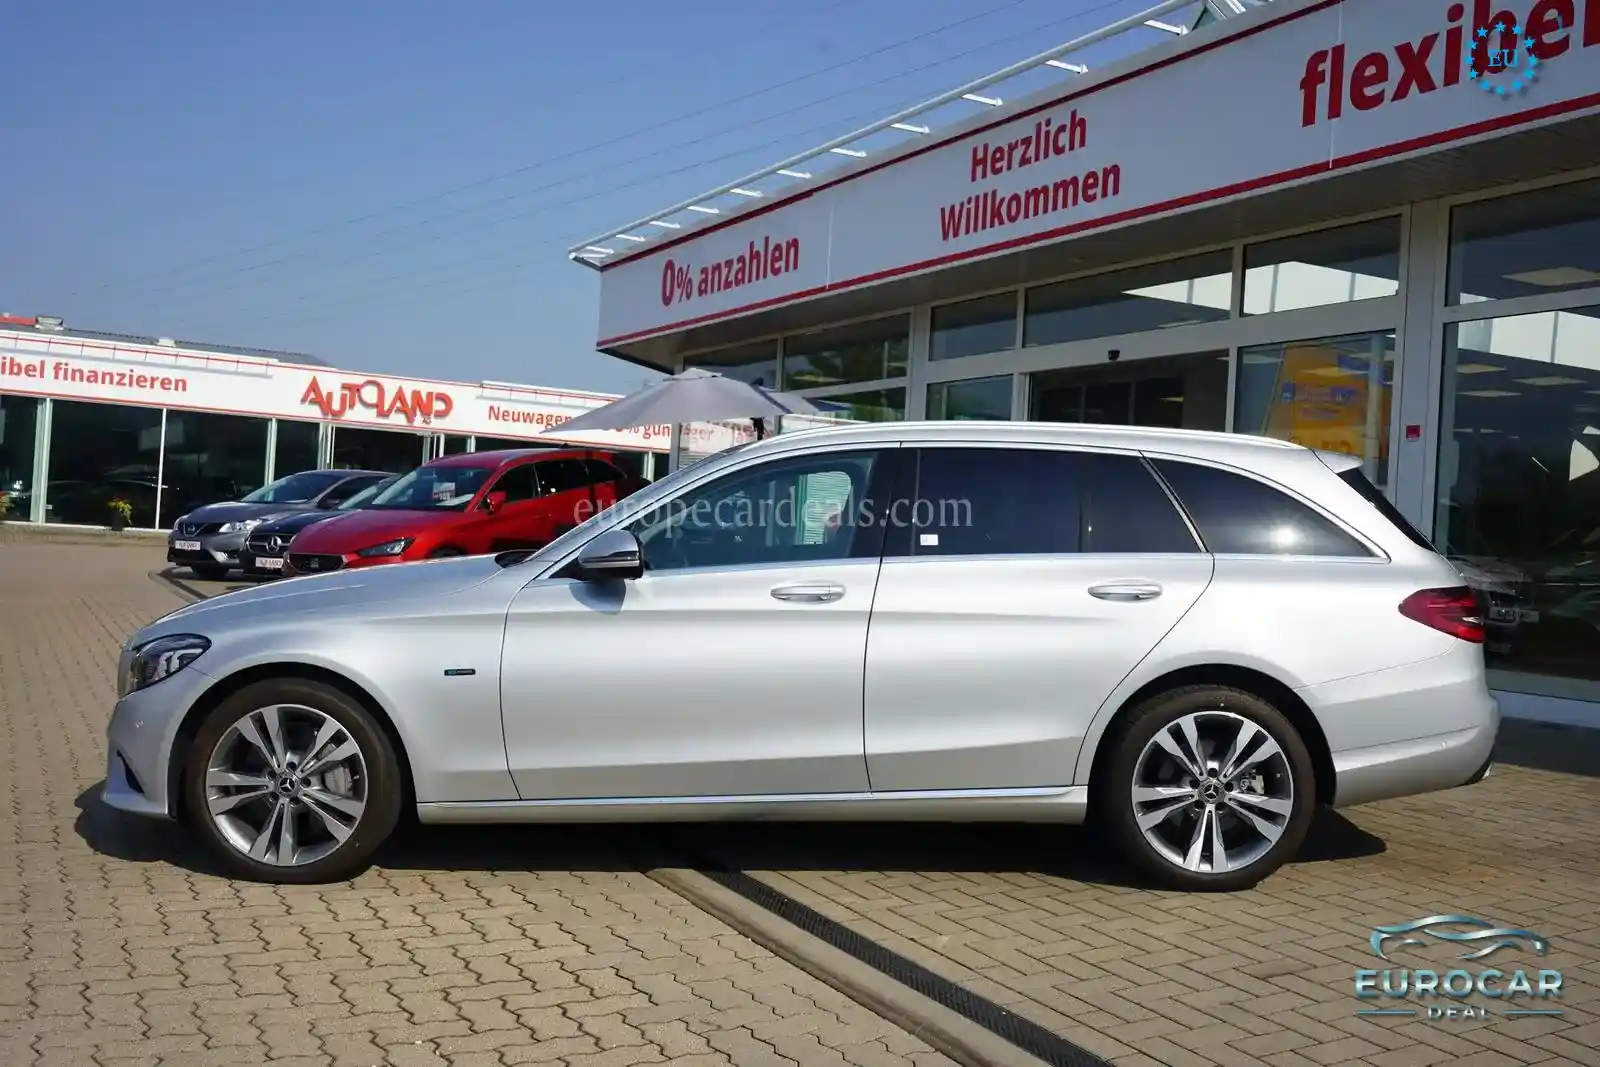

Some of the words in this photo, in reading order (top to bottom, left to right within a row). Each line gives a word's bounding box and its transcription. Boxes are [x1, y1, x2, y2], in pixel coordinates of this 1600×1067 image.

[971, 109, 1087, 182] Herzlich
[940, 163, 1121, 242] Willkommen
[661, 259, 693, 307] 0%
[698, 235, 799, 297] anzahlen
[53, 360, 187, 392] finanzieren
